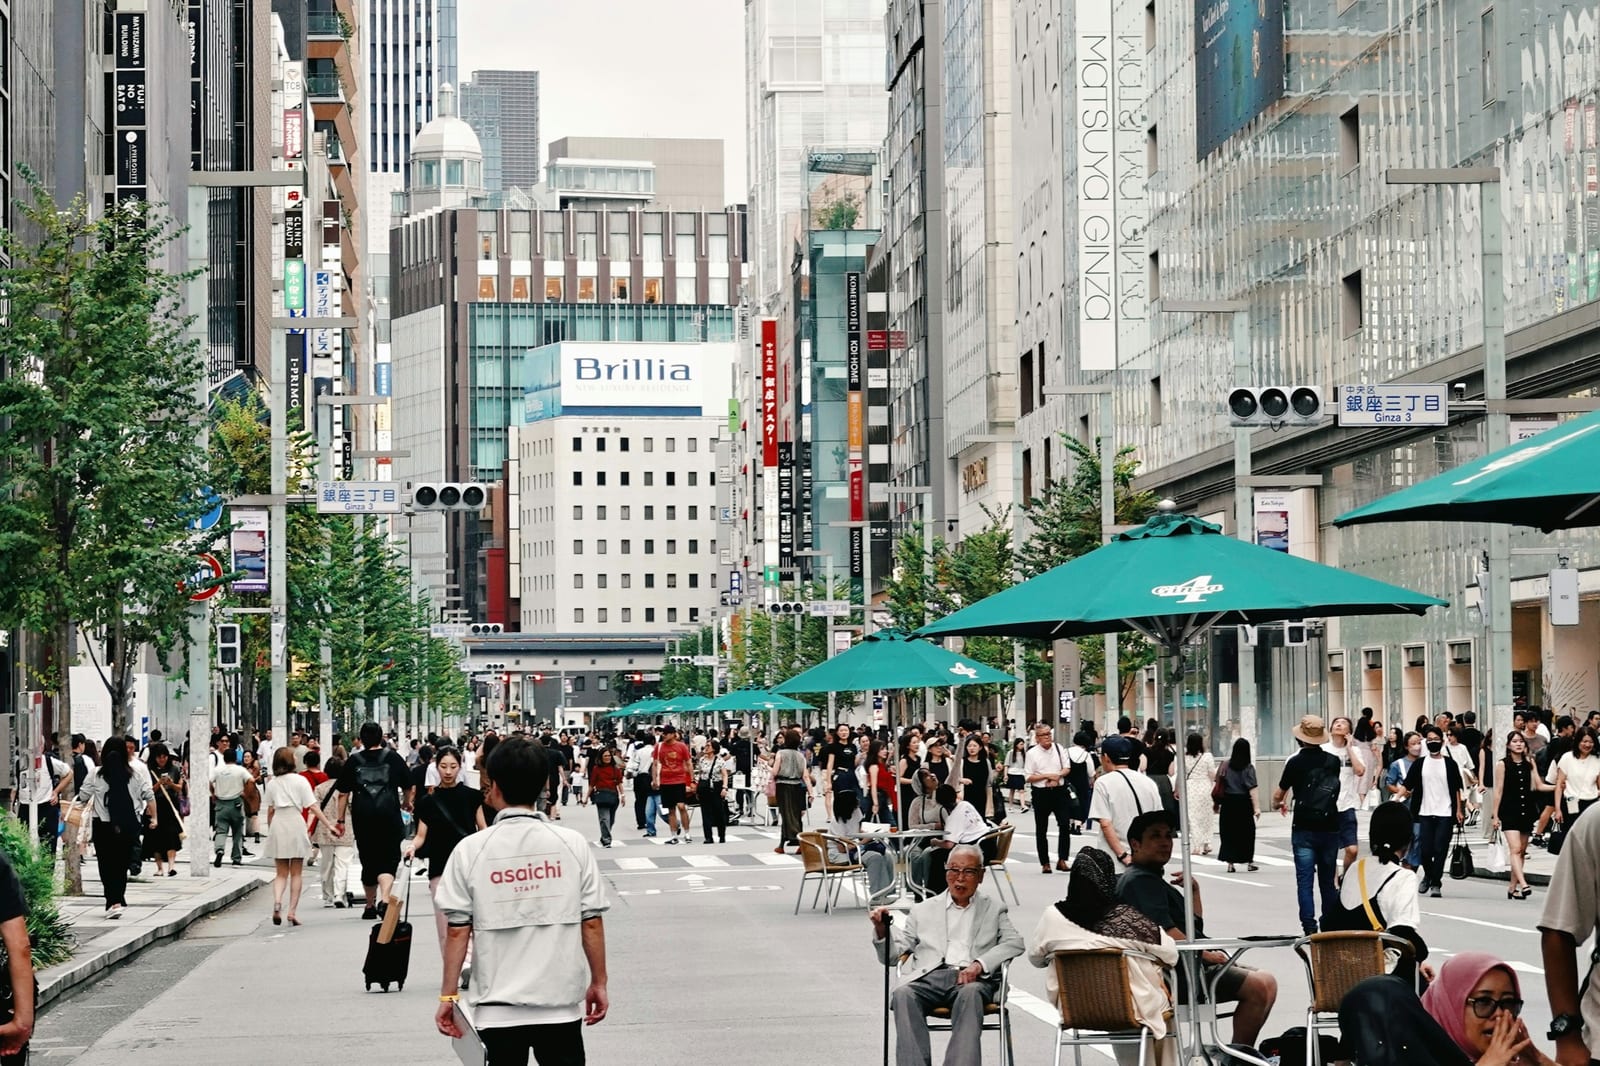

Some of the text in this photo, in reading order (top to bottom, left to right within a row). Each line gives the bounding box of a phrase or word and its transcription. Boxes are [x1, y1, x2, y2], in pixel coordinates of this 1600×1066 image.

[128, 84, 135, 98] NO
[285, 82, 301, 90] TCB
[294, 216, 302, 247] CLINIC
[849, 275, 857, 318] KOMEHYO
[574, 357, 692, 381] Brillia
[290, 358, 299, 408] I-PRIMO
[1346, 385, 1376, 395] 中央区
[1346, 395, 1440, 412] 銀座三丁目
[764, 377, 775, 445] 銀座アスター
[1374, 412, 1412, 422] Ginza 3
[322, 481, 346, 489] 中央区
[323, 489, 395, 502] 銀座三丁目
[344, 502, 374, 511] Ginza 3
[852, 530, 860, 573] KOMEHYO
[1154, 584, 1222, 594] Ginza
[490, 860, 562, 884] asaichi
[514, 884, 540, 893] STAFF
